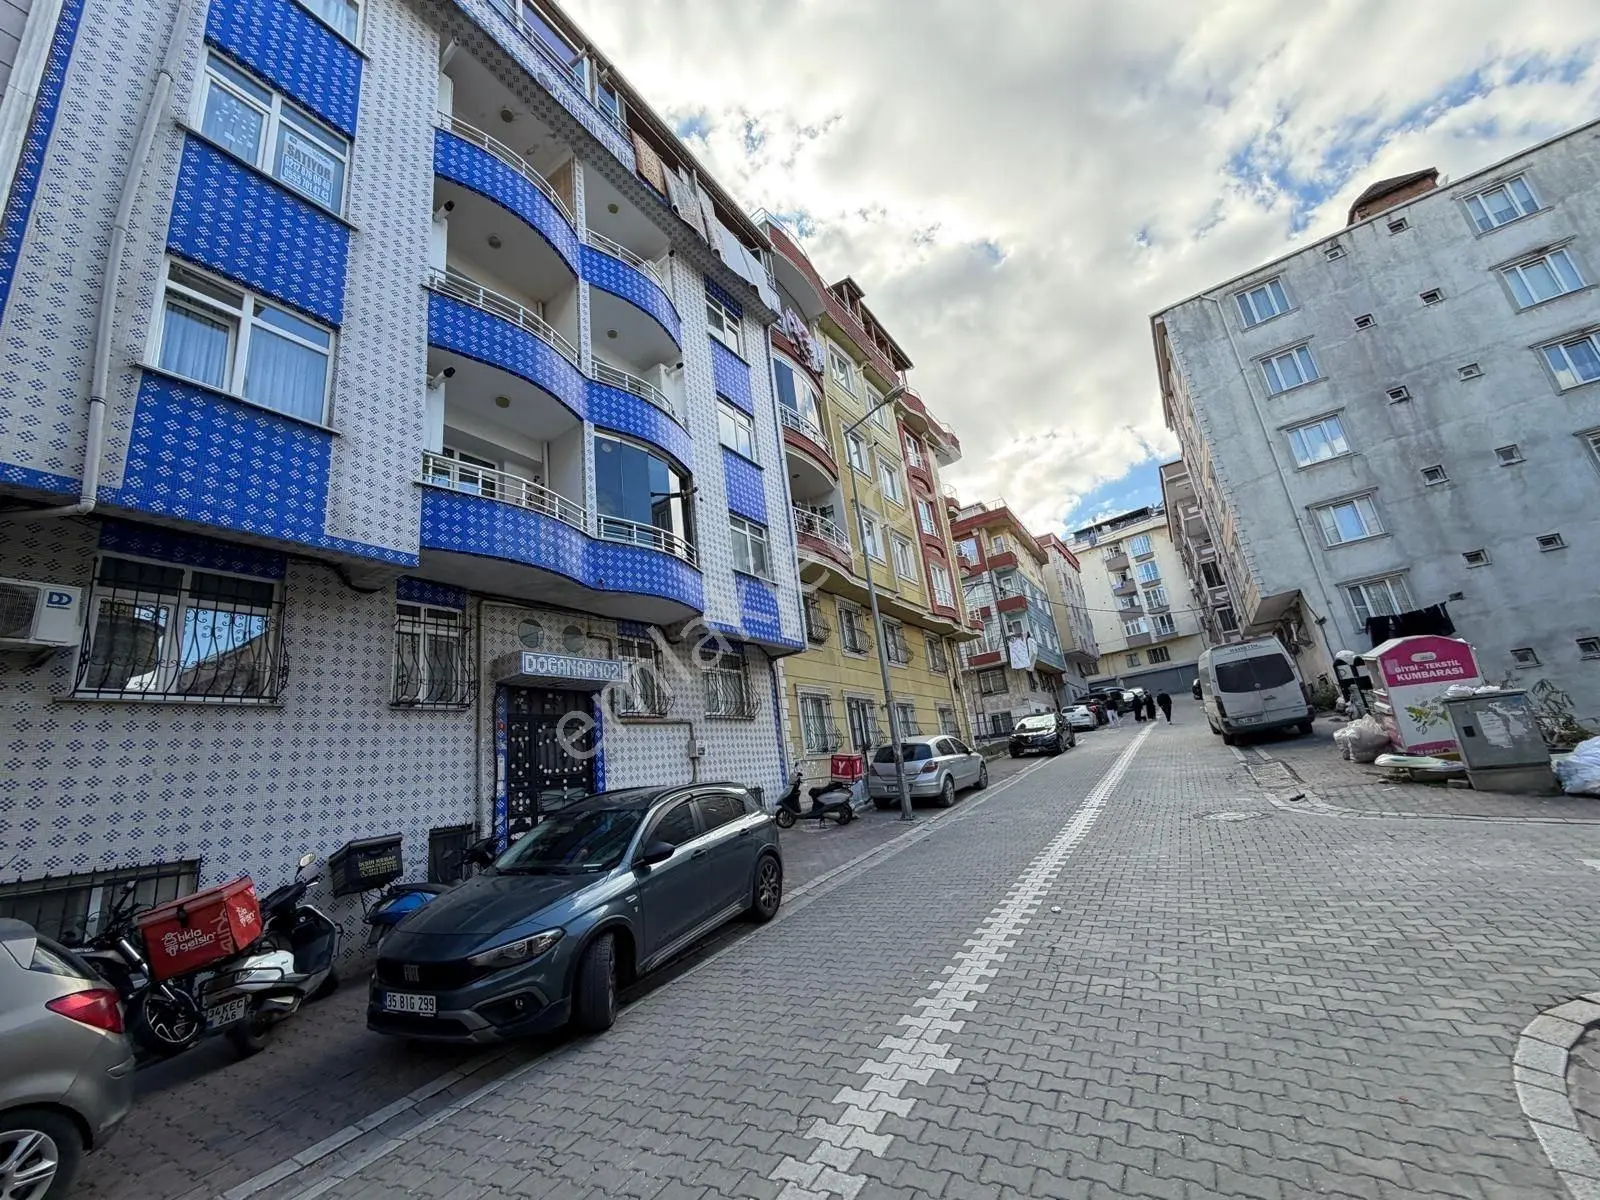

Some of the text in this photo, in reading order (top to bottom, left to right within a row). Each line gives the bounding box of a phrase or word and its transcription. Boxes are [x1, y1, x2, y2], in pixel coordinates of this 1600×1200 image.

[287, 144, 331, 181] SATIYOR
[1424, 660, 1461, 669] TEKSTİL
[1396, 666, 1464, 681] KUMBARASI
[838, 760, 846, 774] Y
[387, 994, 396, 1008] 35
[418, 996, 434, 1012] 299
